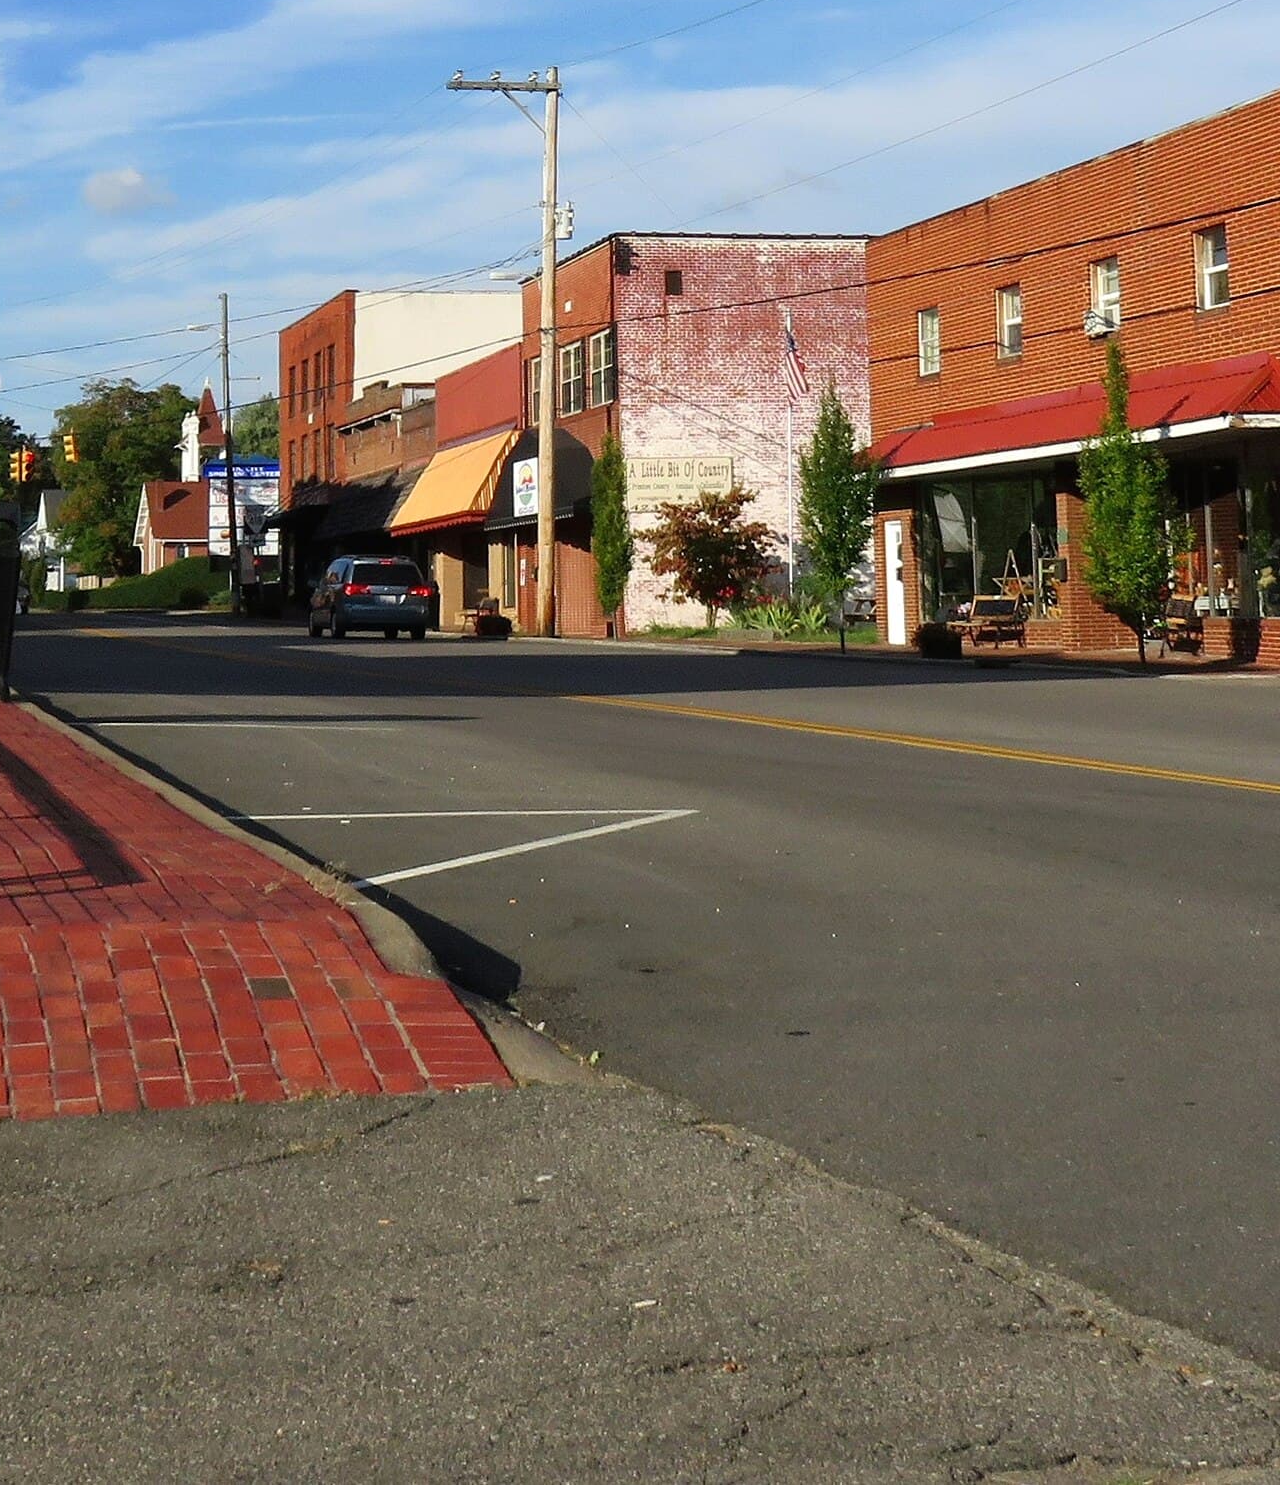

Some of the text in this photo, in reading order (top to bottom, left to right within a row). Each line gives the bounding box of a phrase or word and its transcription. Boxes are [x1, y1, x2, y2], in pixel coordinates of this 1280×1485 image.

[629, 459, 730, 482] A Little Bit Of Country
